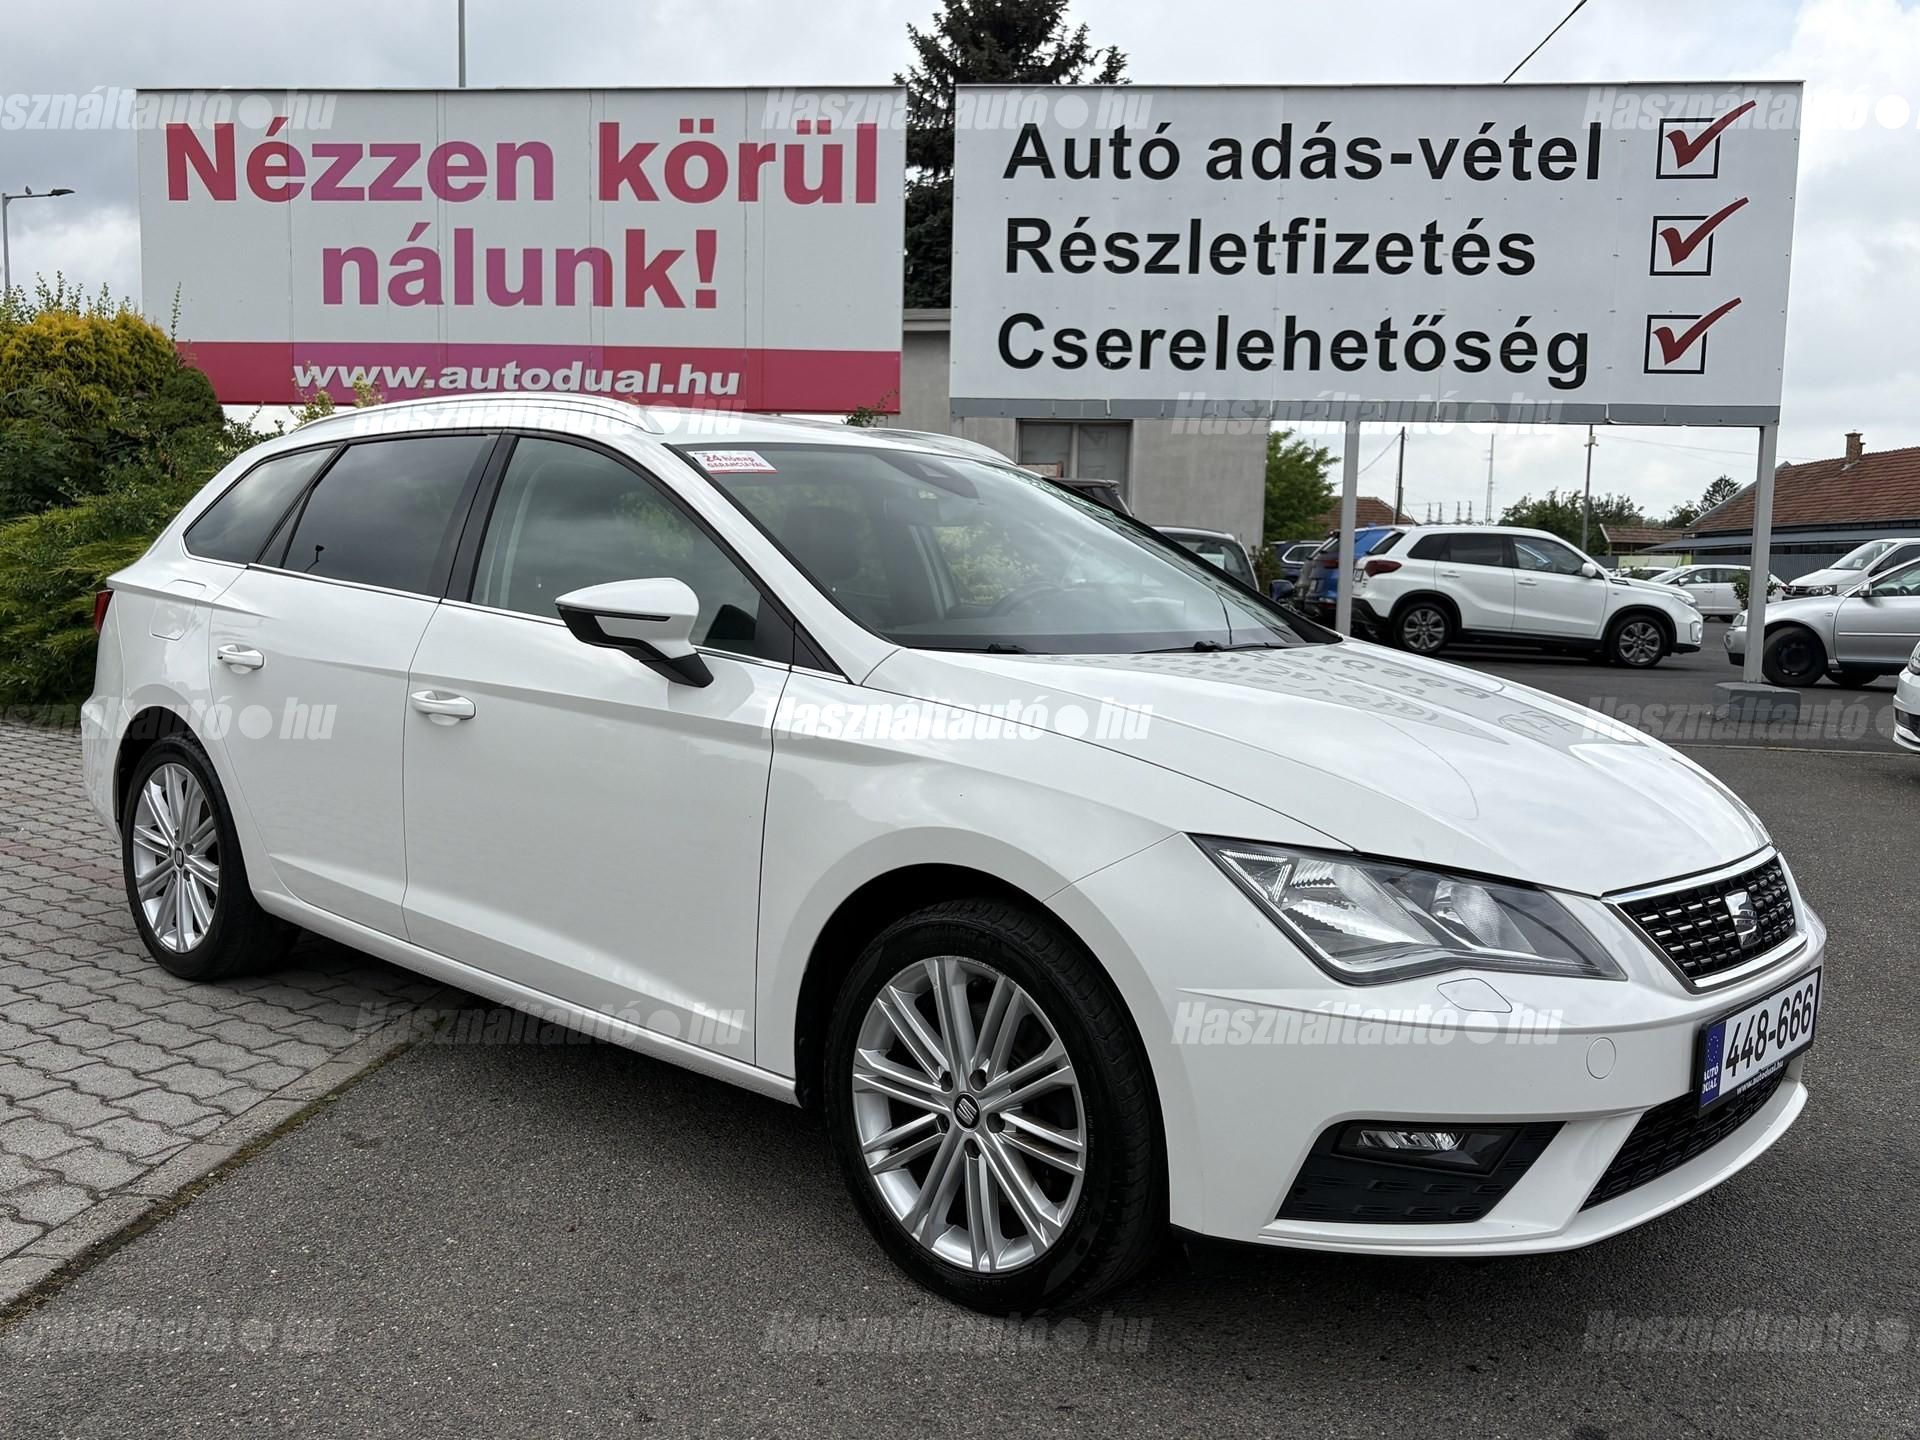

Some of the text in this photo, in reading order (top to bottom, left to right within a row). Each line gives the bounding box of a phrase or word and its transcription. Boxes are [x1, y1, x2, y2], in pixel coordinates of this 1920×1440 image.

[166, 116, 877, 205] Nézzen körül
[1001, 121, 1602, 182] Autó adás-vétel
[322, 222, 718, 310] nálunk!
[1006, 215, 1536, 276] Részletfizetés
[293, 359, 741, 396] www.autodual.hu
[998, 312, 1589, 390] Cserelehetőség
[1725, 983, 1814, 1077] 448-666
